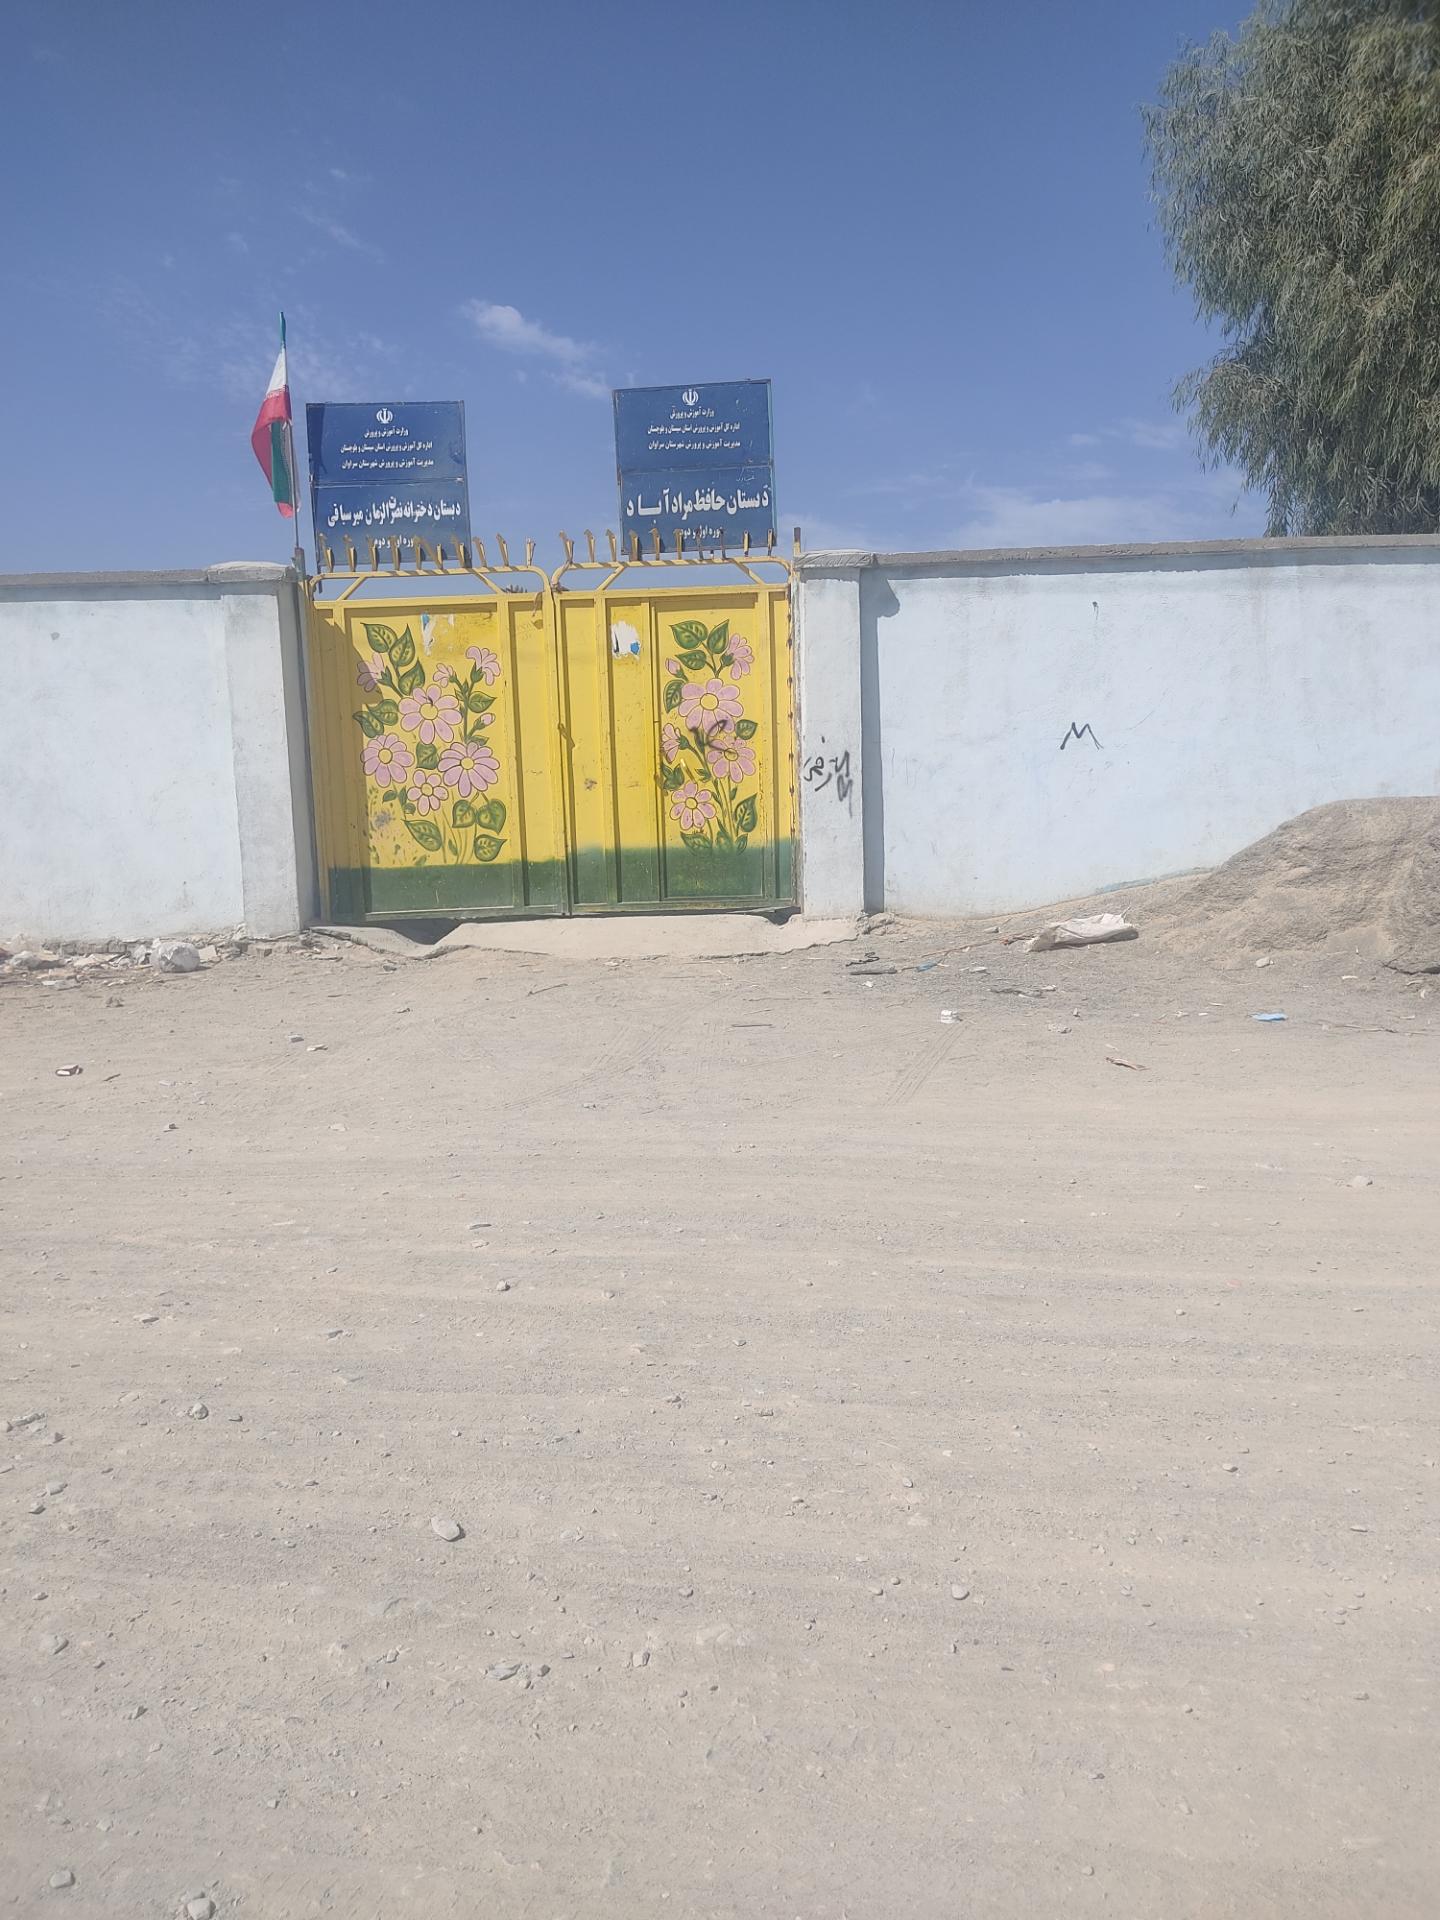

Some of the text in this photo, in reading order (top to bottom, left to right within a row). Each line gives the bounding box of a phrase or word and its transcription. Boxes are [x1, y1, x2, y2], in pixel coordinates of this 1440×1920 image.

[670, 408, 683, 419] پرورش
[687, 406, 701, 418] آموزش
[702, 408, 714, 417] وزارت
[381, 426, 395, 437] آموزش
[396, 427, 408, 436] وزارت
[647, 424, 664, 434] بلوچستان
[668, 424, 681, 434] سیستان
[682, 424, 692, 433] استان
[692, 424, 706, 433] پرورش
[709, 422, 722, 432] آموزش
[723, 423, 730, 432] کل
[730, 422, 740, 432] اداره
[364, 429, 378, 438] پرورش
[340, 444, 358, 453] بلوچستان
[361, 444, 374, 452] سیستان
[375, 443, 385, 452] استان
[386, 442, 399, 452] پرورش
[402, 441, 415, 451] آموزش
[416, 442, 422, 451] کل
[422, 441, 432, 451] اداره
[648, 440, 664, 450] سراوان
[664, 440, 684, 450] شهرستان
[685, 440, 701, 450] پرورش
[706, 439, 722, 449] آموزش
[723, 440, 740, 448] مدیریت
[342, 459, 358, 469] سراوان
[358, 459, 378, 469] شهرستان
[379, 459, 394, 468] پرورش
[399, 457, 415, 468] آموزش
[416, 459, 434, 468] مدیریت
[693, 488, 726, 511] حافظ
[403, 500, 432, 522] دخترانه
[434, 499, 460, 520] دبستان
